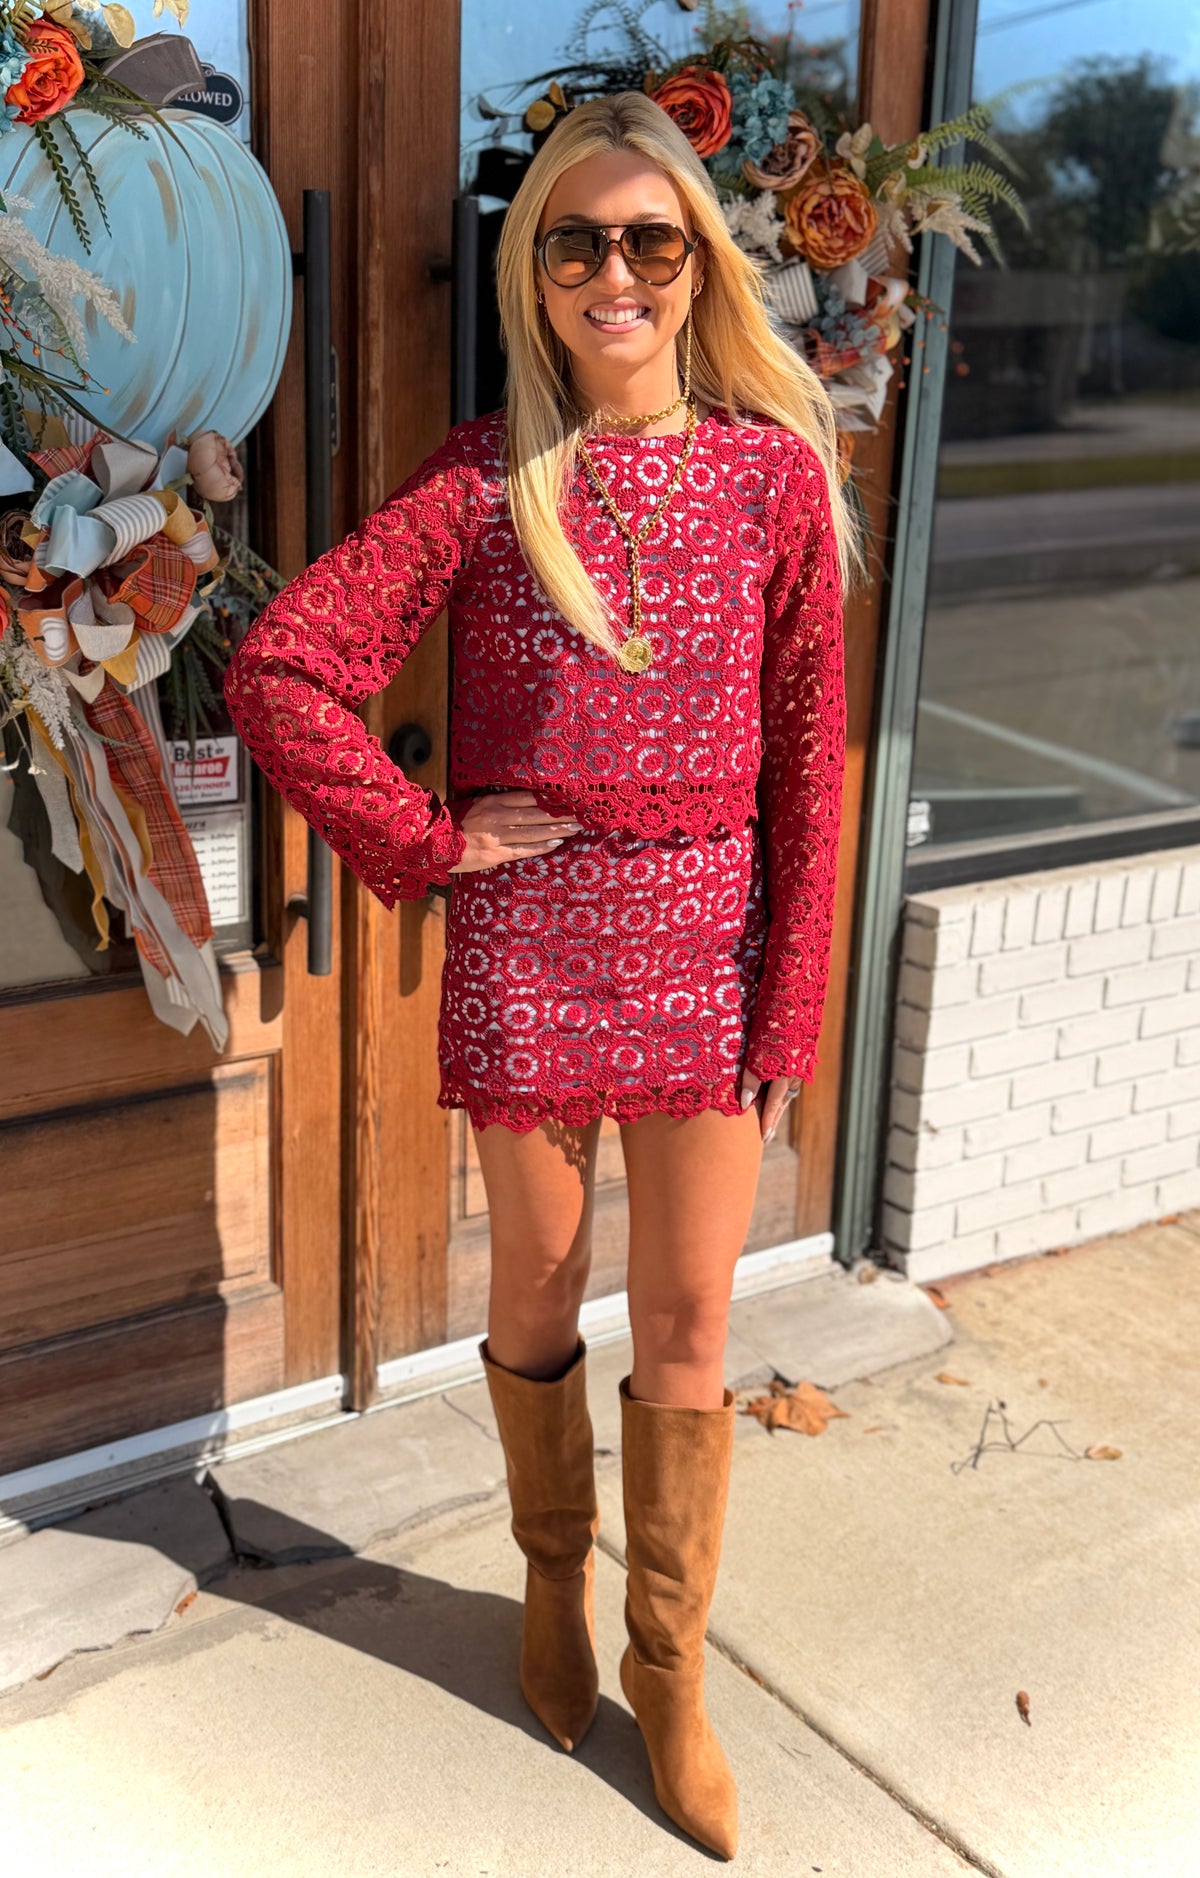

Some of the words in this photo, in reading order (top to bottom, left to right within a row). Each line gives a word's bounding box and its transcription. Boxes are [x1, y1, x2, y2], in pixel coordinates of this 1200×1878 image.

[178, 90, 232, 107] LOWED
[174, 744, 212, 761] Best
[174, 762, 223, 776] Monroe
[194, 781, 231, 790] WINNER
